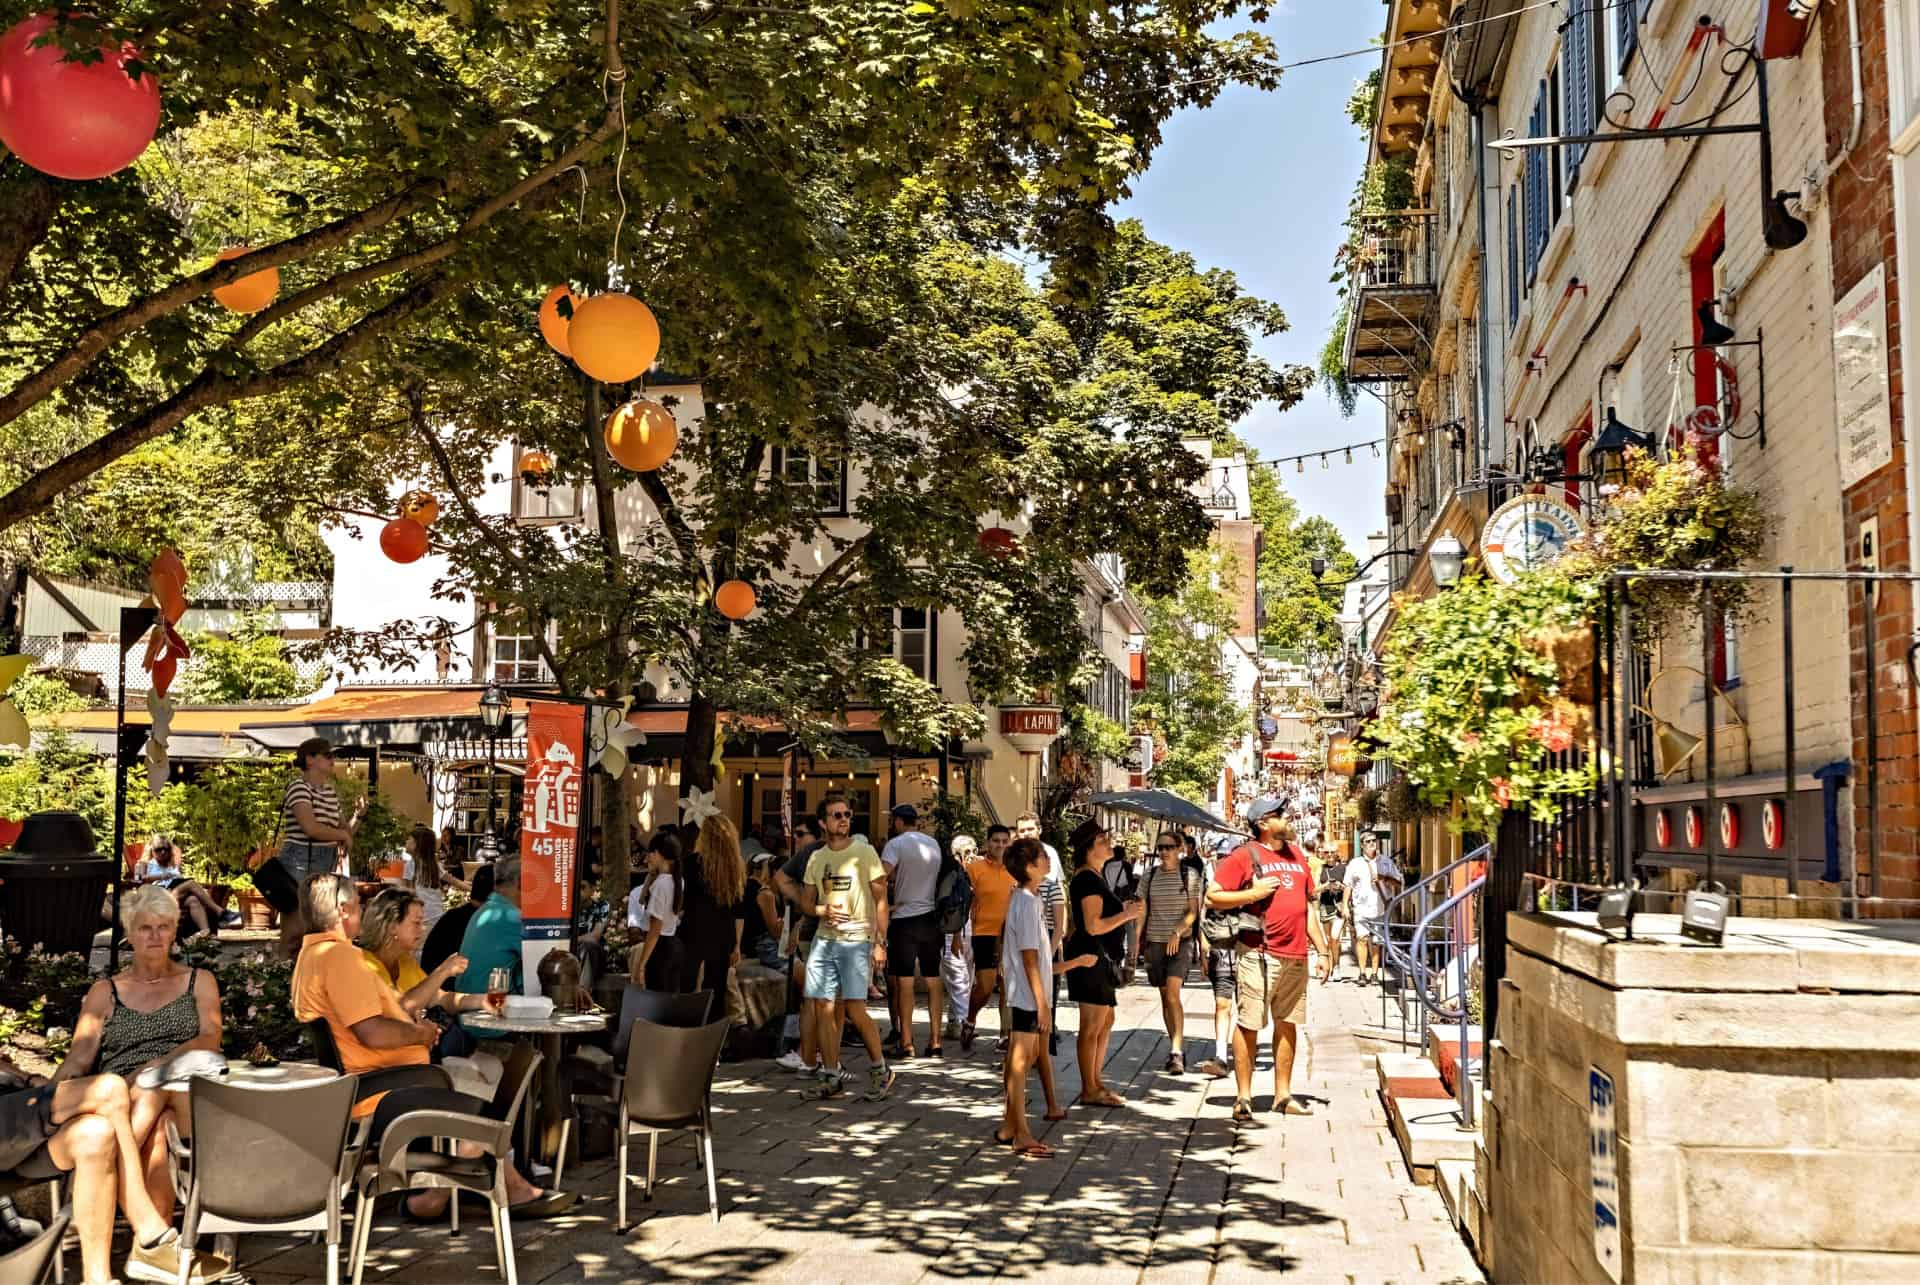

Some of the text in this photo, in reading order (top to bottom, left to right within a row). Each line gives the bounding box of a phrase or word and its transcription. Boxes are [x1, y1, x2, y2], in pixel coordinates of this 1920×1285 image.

[1505, 501, 1580, 537] CITAINE
[1025, 713, 1053, 730] LAPIN
[531, 838, 553, 855] 45
